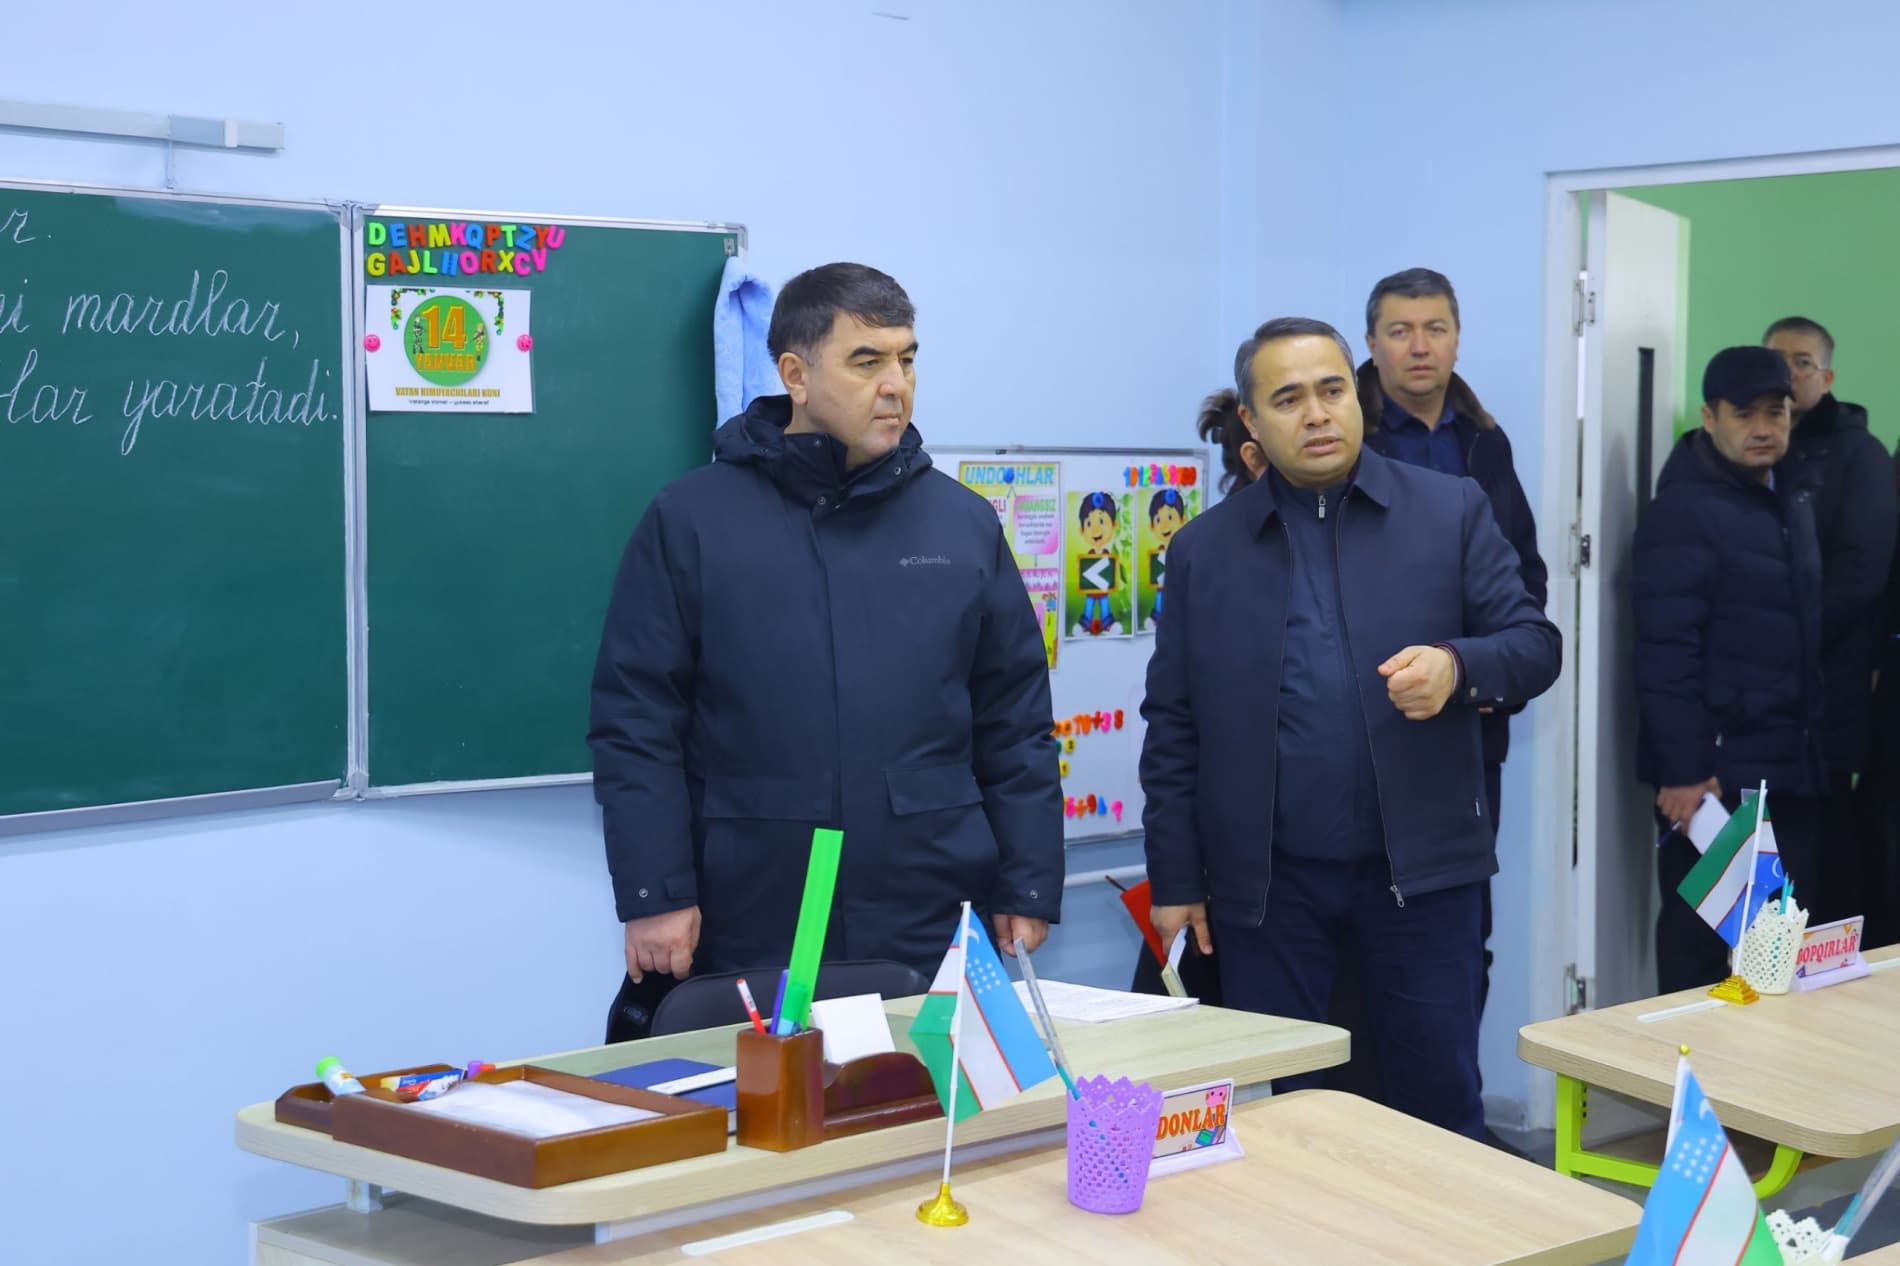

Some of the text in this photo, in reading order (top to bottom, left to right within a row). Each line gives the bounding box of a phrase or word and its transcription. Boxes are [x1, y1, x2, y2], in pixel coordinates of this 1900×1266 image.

[62, 269, 301, 350] mardlar,
[421, 303, 467, 350] 14
[120, 356, 339, 456] yaratadi.
[965, 464, 1055, 485] UNDOHLAR
